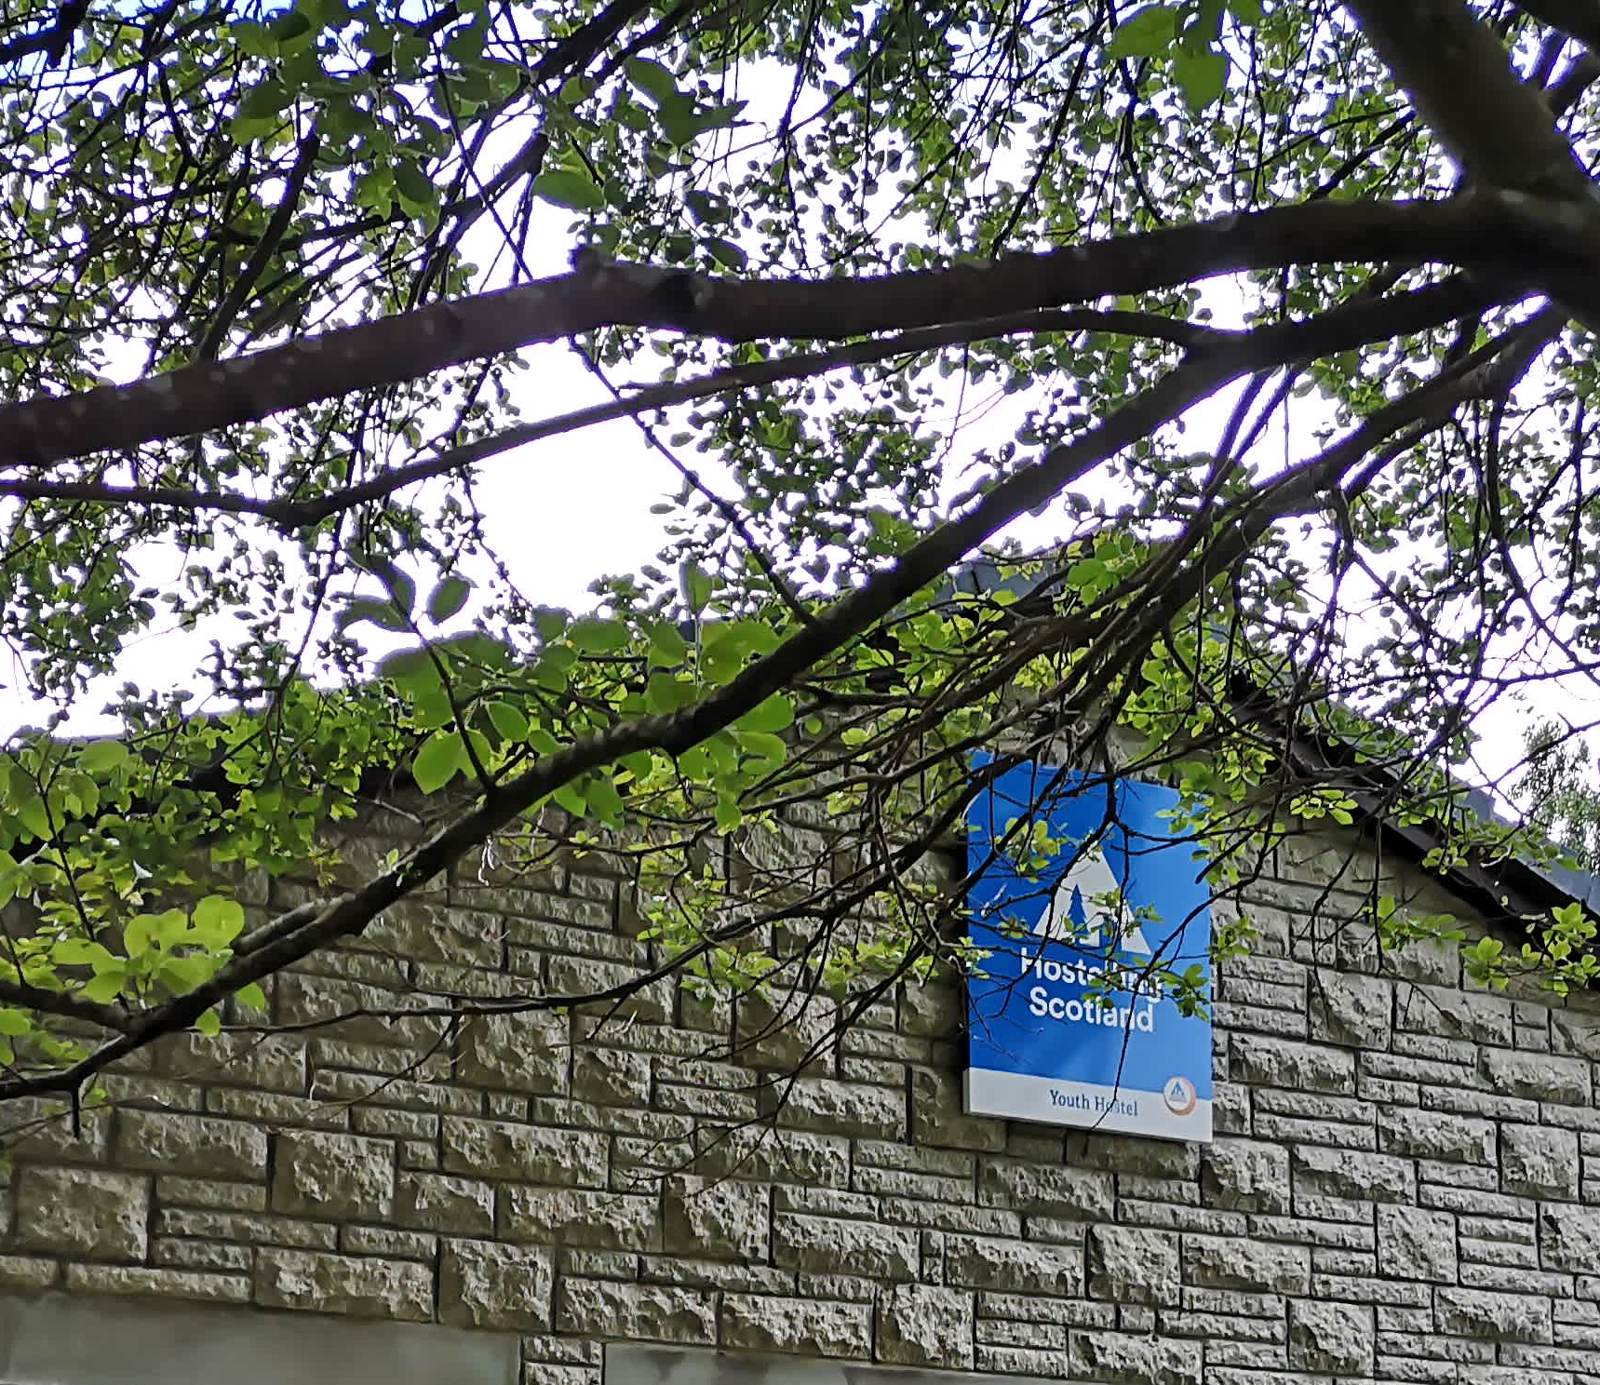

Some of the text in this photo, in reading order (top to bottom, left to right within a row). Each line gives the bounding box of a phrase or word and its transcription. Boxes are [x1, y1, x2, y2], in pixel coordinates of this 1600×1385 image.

[1029, 986, 1154, 1033] Scotland
[1050, 1089, 1139, 1117] Youth Hostel
